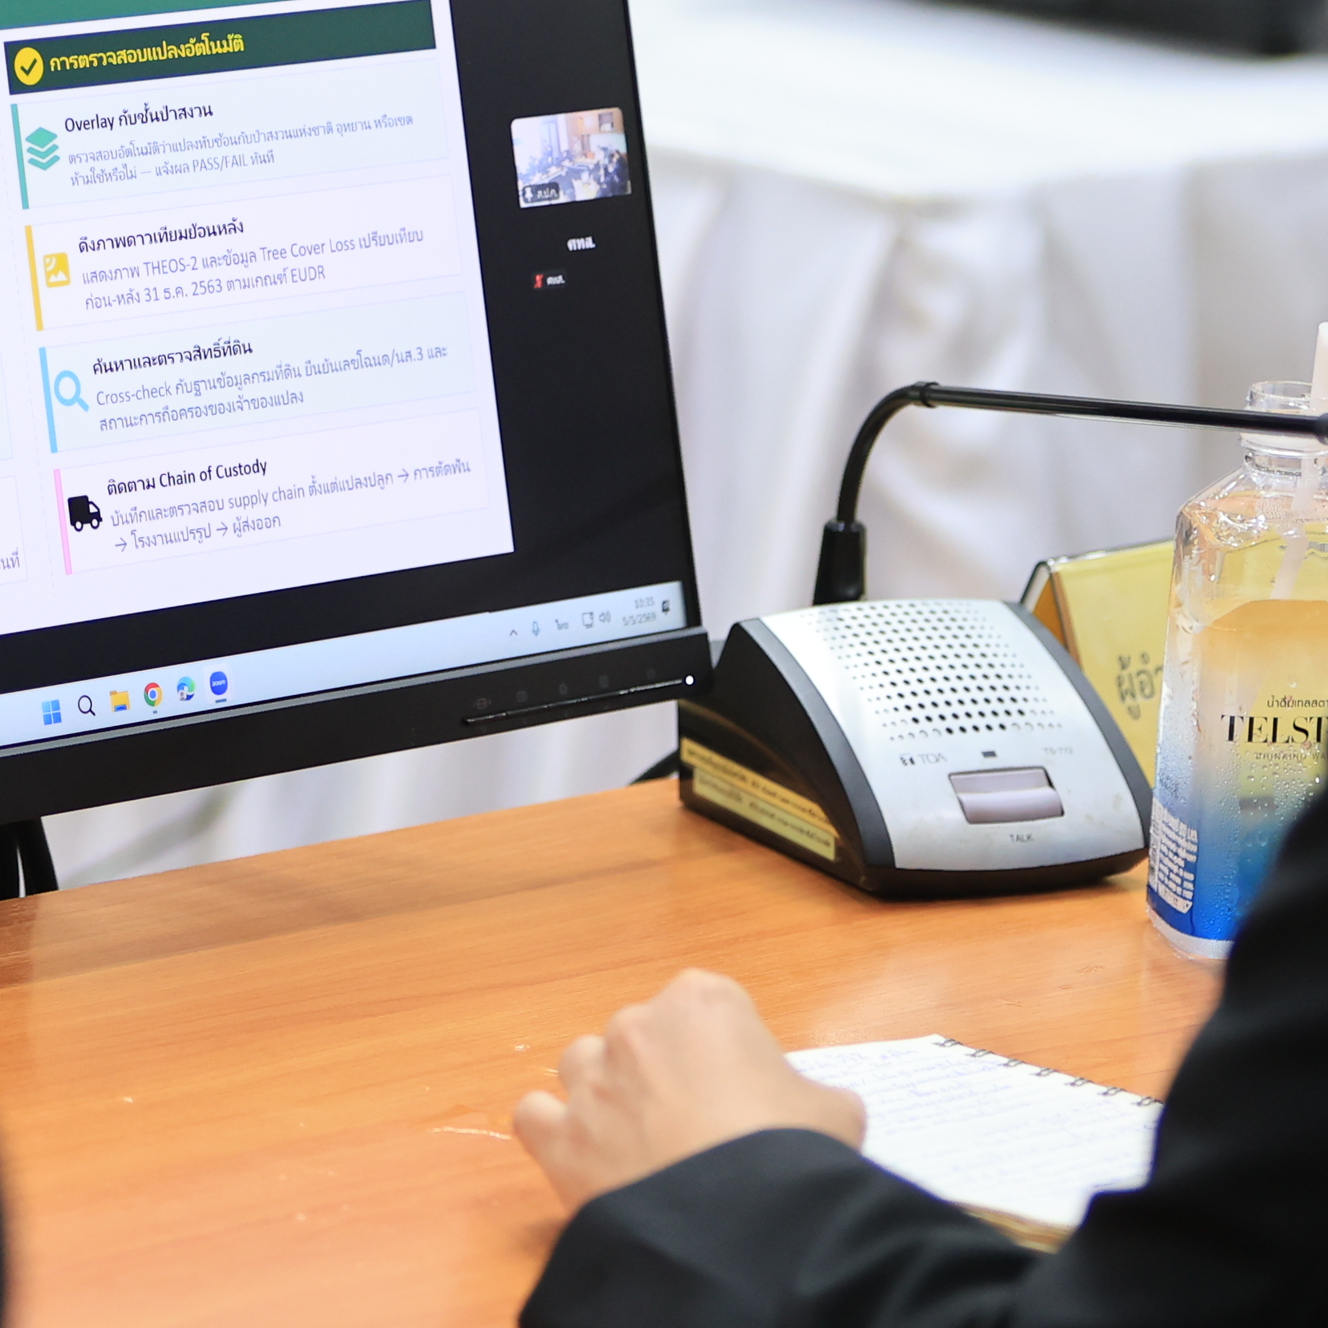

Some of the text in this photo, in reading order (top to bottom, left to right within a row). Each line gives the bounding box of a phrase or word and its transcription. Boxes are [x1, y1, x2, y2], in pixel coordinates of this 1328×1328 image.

[63, 112, 115, 133] Overlay
[191, 152, 249, 173] PASS/FAIL
[141, 254, 199, 277] THEOS-2
[258, 245, 288, 262] Tree
[289, 241, 327, 258] Cover
[328, 237, 356, 254] Loss
[143, 285, 160, 303] 31
[190, 277, 223, 297] 2563
[289, 263, 327, 284] EUDR
[95, 380, 173, 407] Cross-check
[158, 469, 196, 488] Chain
[198, 464, 213, 482] of
[214, 457, 268, 480] Custody
[226, 488, 269, 511] supply
[270, 483, 306, 503] chain
[1312, 752, 1328, 761] WA
[1009, 833, 1034, 844] TALK
